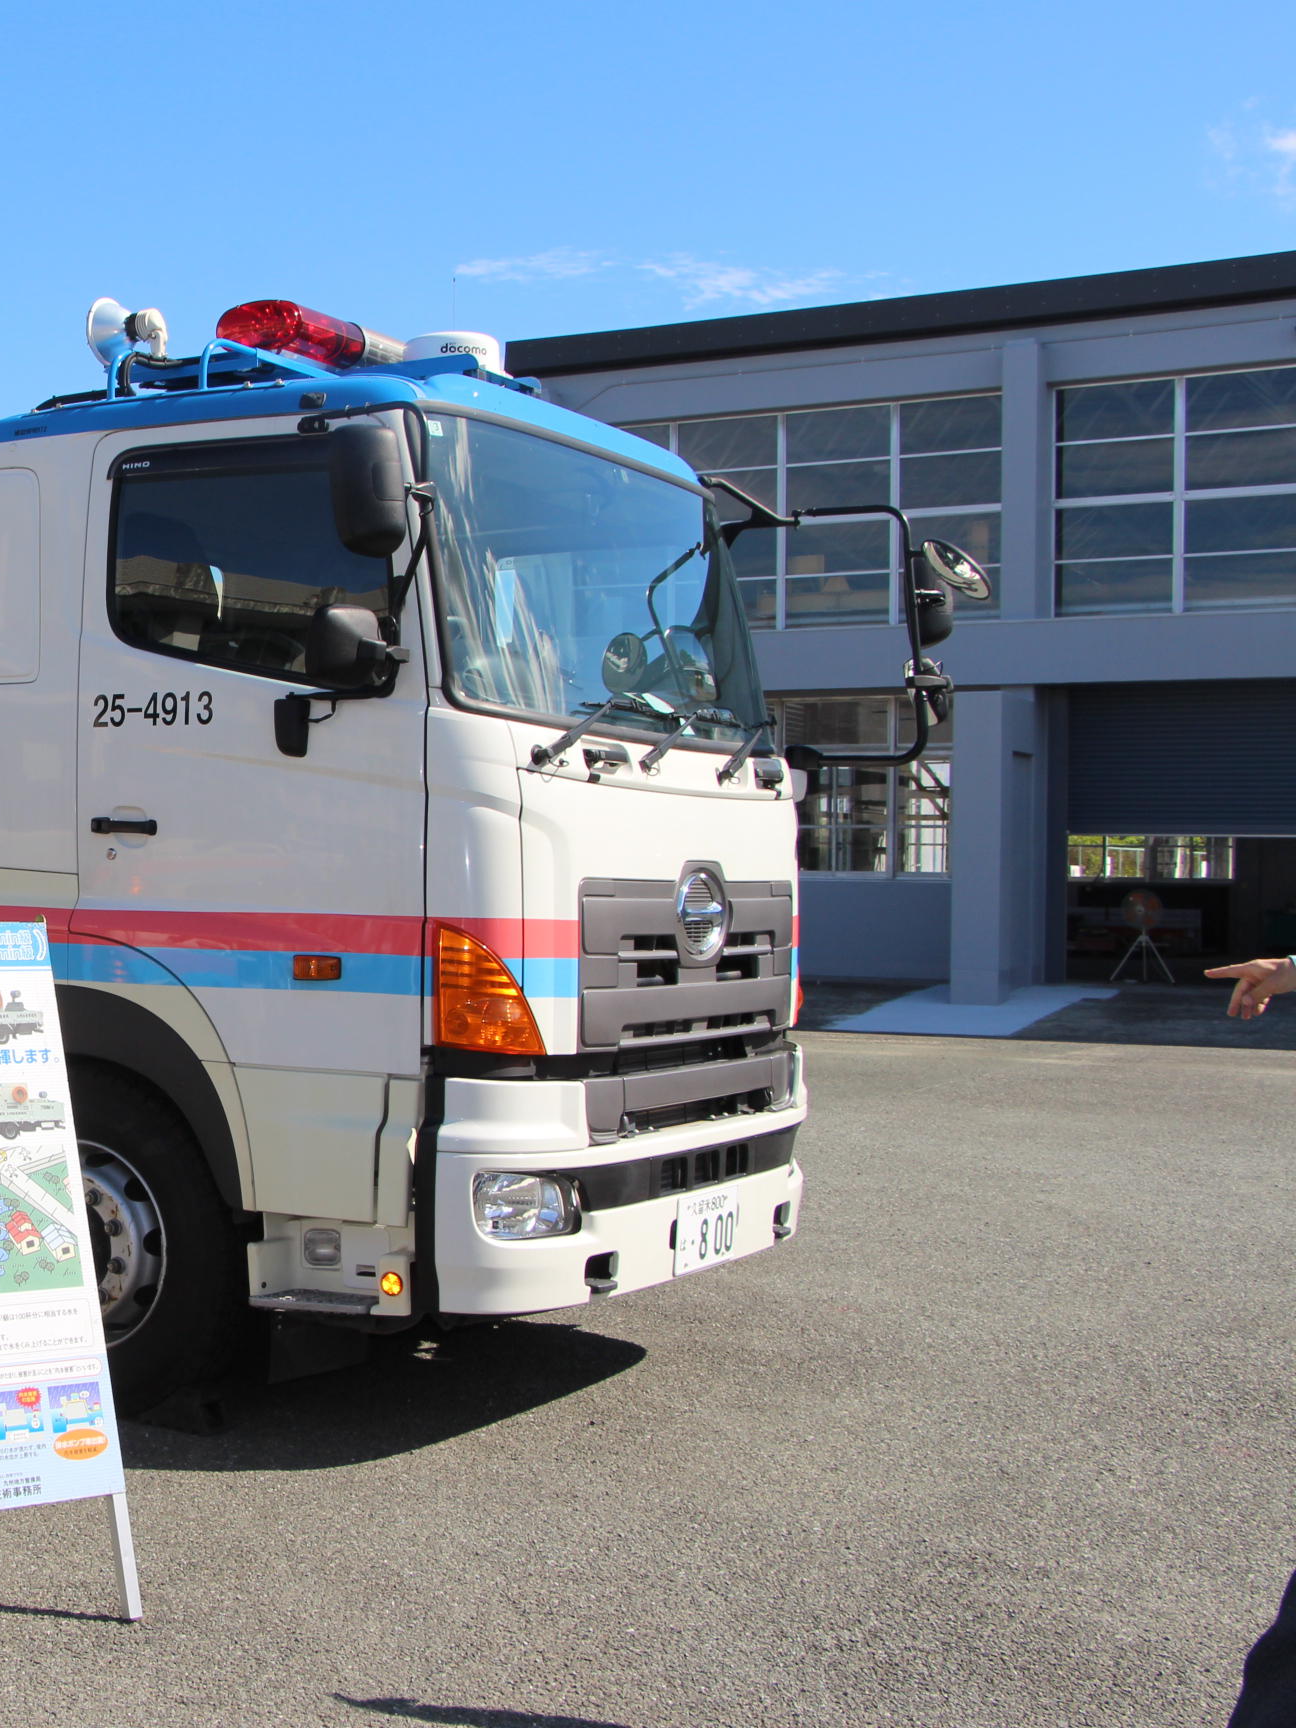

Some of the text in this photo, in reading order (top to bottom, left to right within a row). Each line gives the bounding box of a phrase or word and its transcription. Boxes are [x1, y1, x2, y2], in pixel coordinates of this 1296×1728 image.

[440, 342, 487, 356] docomo
[122, 461, 150, 469] HINO
[93, 690, 214, 728] 25-4913
